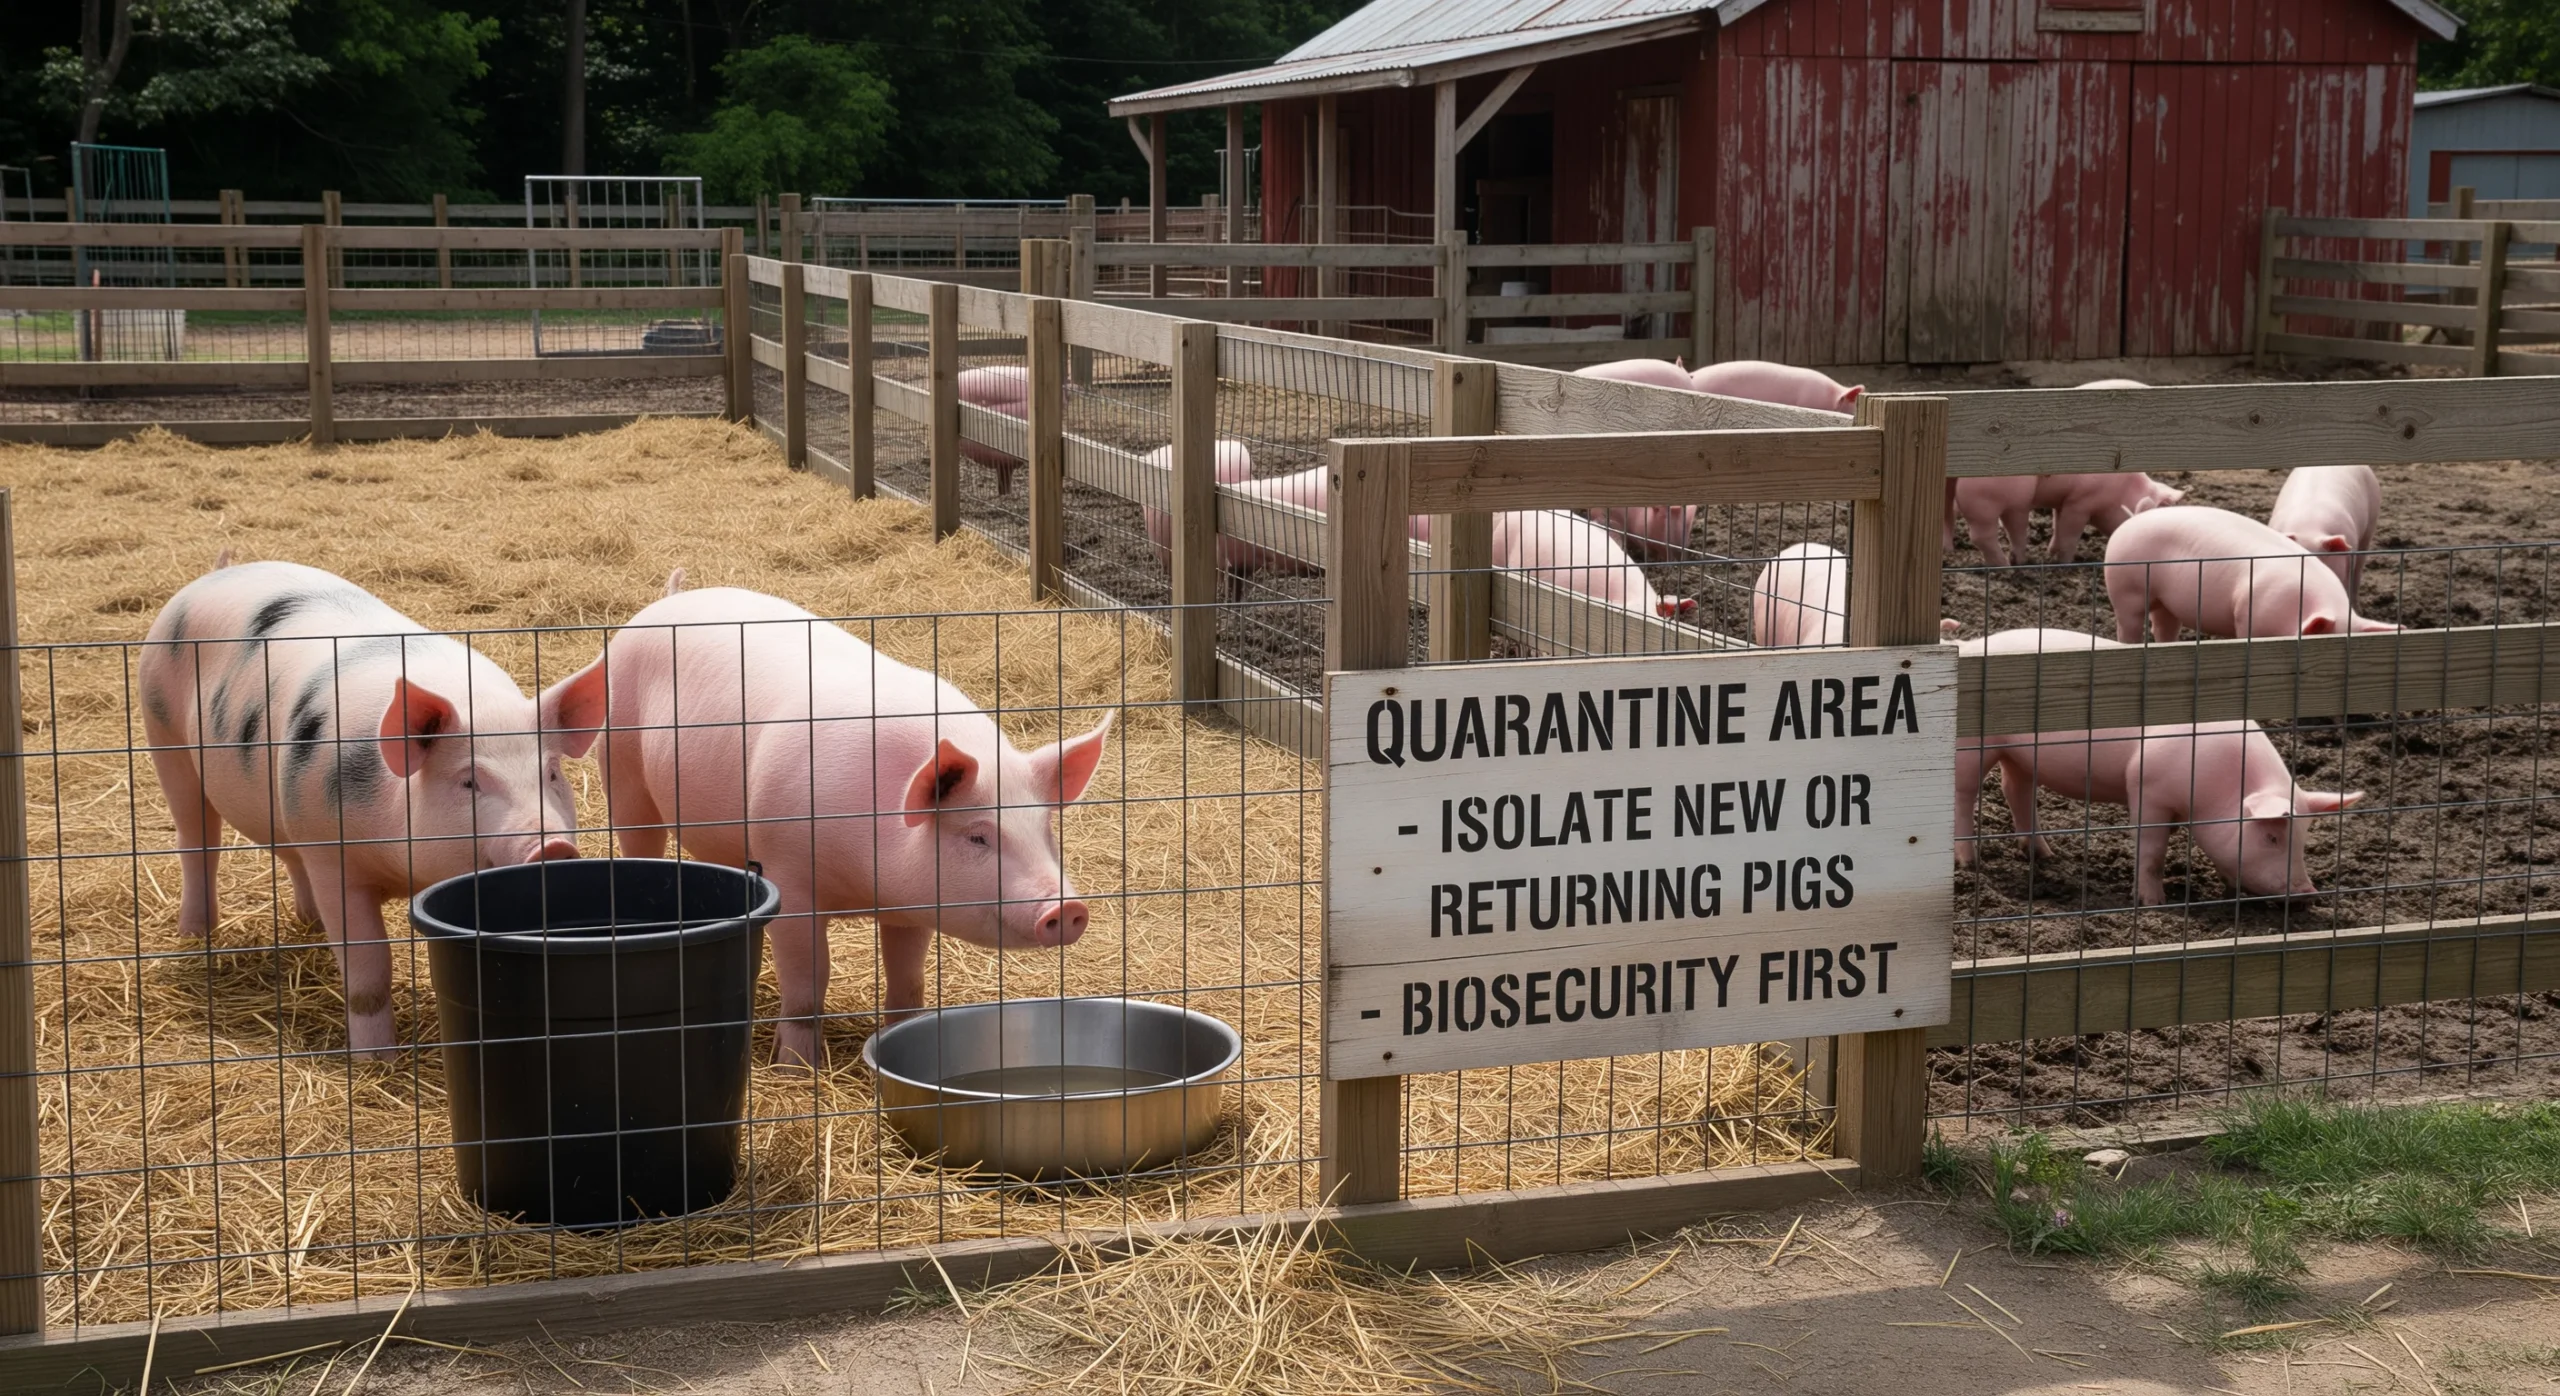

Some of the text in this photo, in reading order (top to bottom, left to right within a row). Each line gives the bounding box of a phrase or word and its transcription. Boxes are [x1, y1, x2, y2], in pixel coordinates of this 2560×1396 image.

[1367, 673, 1920, 768] QUARANTINE AREA
[1442, 787, 1653, 853] ISOLATE
[1675, 779, 1787, 837] NEW
[1806, 774, 1871, 828] OR
[1431, 855, 1854, 938] RETURNING PIGS
[1403, 955, 1740, 1035] BIOSECURITY
[1759, 942, 1898, 1005] FIRST
